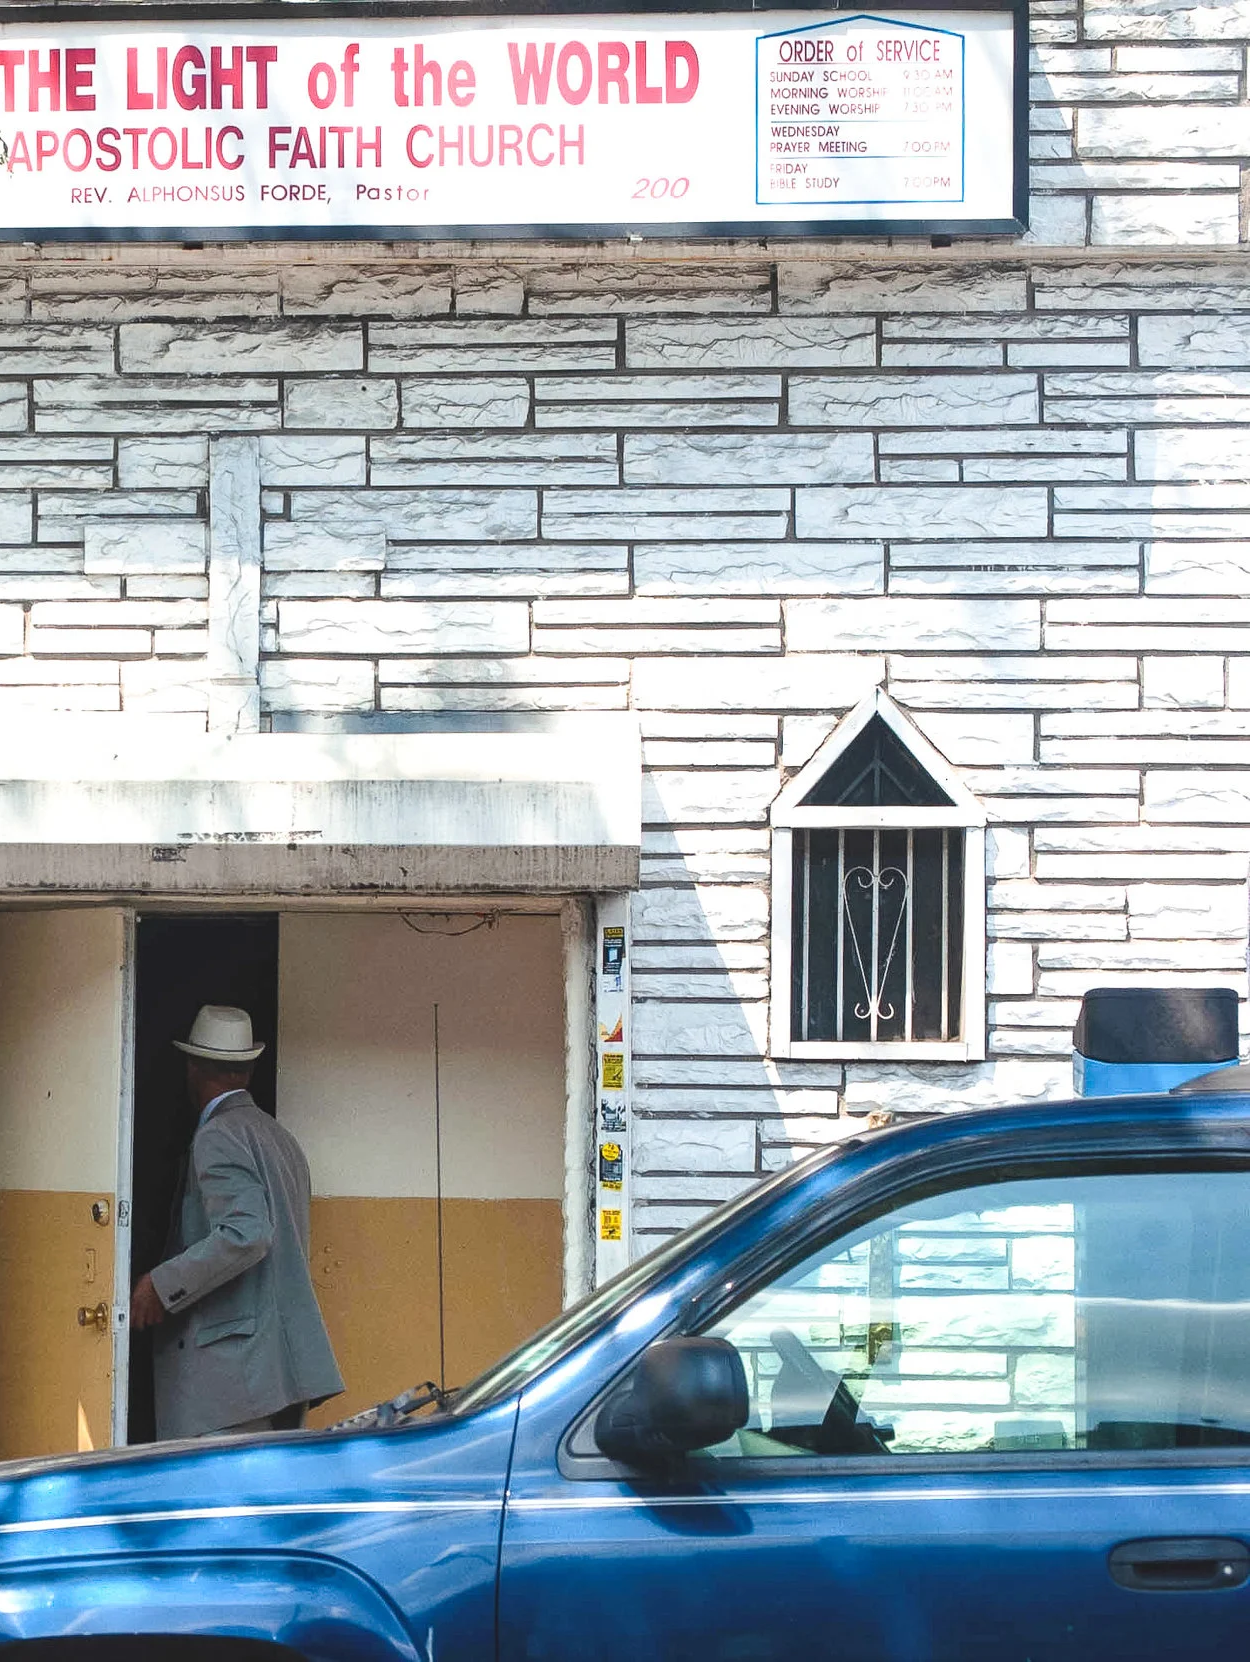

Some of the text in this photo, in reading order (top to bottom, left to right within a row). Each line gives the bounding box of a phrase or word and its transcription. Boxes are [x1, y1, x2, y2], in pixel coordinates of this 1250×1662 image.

[779, 39, 940, 62] ORDER of SERVICE
[126, 45, 278, 111] LIGHT
[307, 42, 360, 109] of
[390, 44, 476, 107] the
[507, 40, 700, 106] WORLD
[770, 71, 814, 82] SUNDAY
[821, 70, 872, 82] SCHOOL
[771, 87, 829, 99] MORNING
[771, 104, 820, 115] EVENING
[828, 103, 880, 115] WORSHIP
[771, 126, 840, 137] WEDNESDAY
[7, 125, 246, 172] APOSTOLIC
[268, 125, 382, 169] FAITH
[406, 123, 584, 168] CHURCH
[770, 142, 810, 152] PRAYER
[819, 141, 867, 153] MEETING
[770, 163, 808, 174] FRIDAY
[632, 177, 690, 198] 200
[770, 178, 796, 189] BIBLE
[806, 177, 840, 188] STUDY
[71, 183, 429, 205] REV. ALPHONSUS FORDE, Pastor
